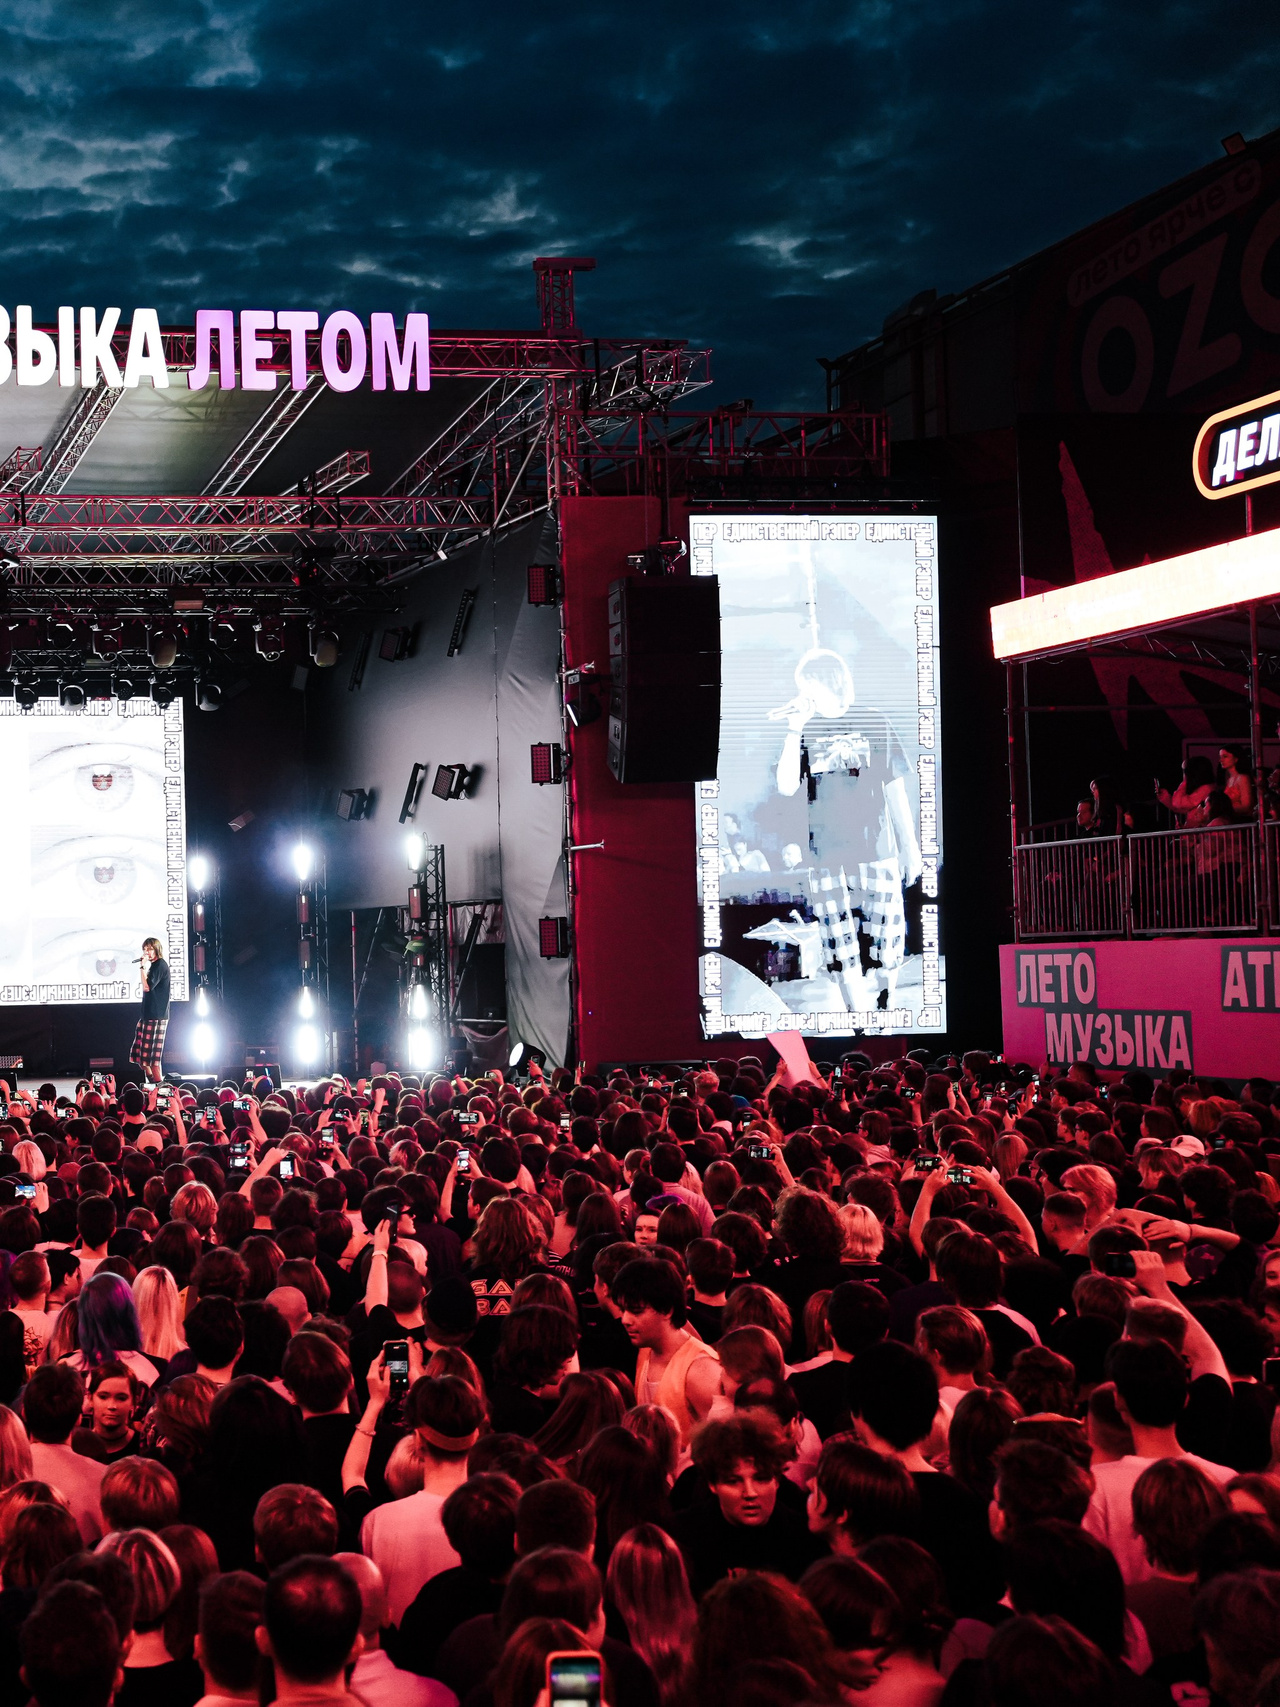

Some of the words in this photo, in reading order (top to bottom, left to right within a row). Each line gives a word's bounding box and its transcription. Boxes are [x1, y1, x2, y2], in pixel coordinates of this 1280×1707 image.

[186, 308, 430, 393] ЛЕТОМ
[723, 519, 820, 543] ЕДИНСТВЕННЫЙ
[821, 522, 861, 541] РЭПЕР
[914, 605, 937, 706] ЕДИНСТВЕННЫЙ
[917, 754, 940, 854] ЕДИНСТВЕННЫЙ
[1018, 951, 1096, 1005] ЛЕТО
[1045, 1013, 1192, 1071] МУЗЫКА
